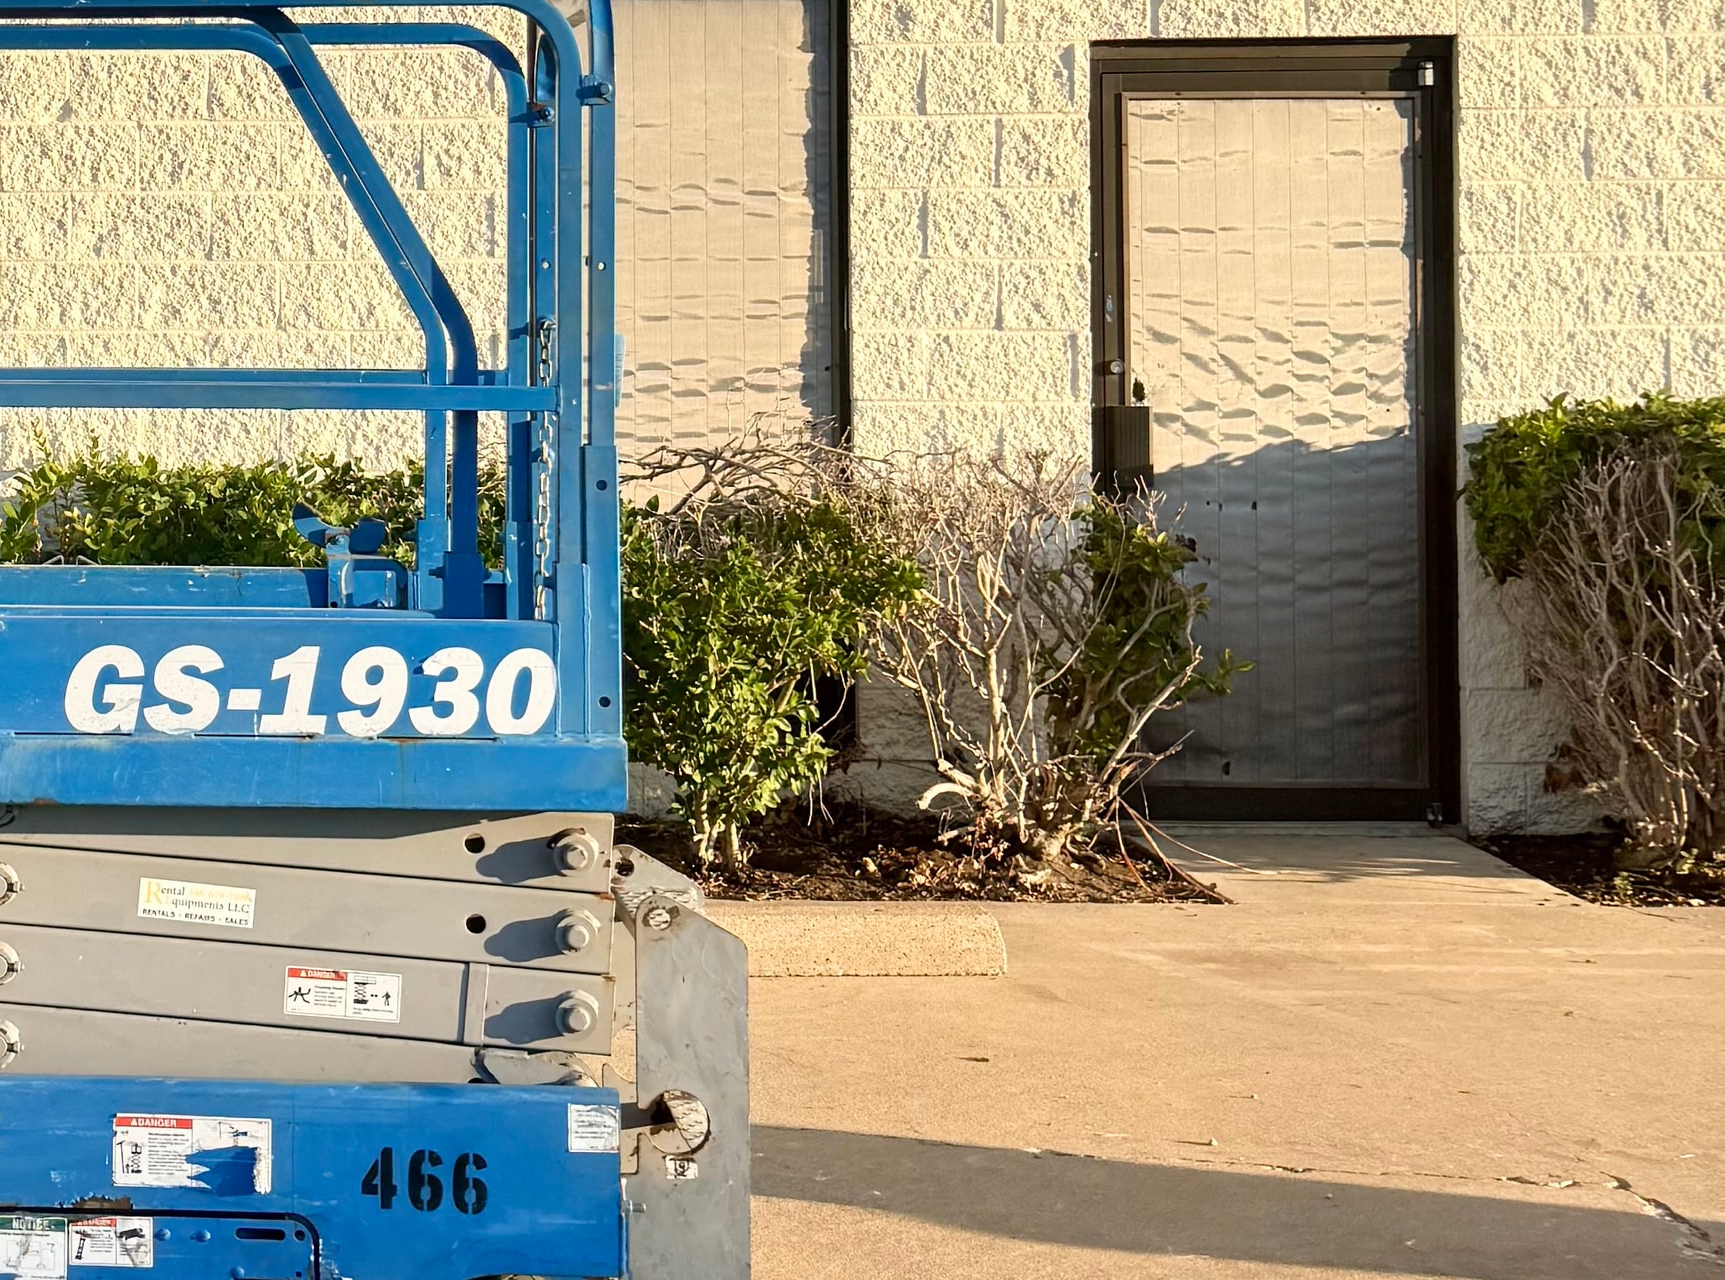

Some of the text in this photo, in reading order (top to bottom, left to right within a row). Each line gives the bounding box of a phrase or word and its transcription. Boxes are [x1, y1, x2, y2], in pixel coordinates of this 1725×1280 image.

[63, 644, 557, 736] GS-1930
[145, 881, 185, 905] Rental
[227, 902, 250, 913] LLC
[142, 908, 249, 926] RENTALS REPAIRS SALES
[138, 1118, 176, 1128] DANGER
[361, 1146, 488, 1215] 466
[13, 1218, 50, 1230] NOTICE
